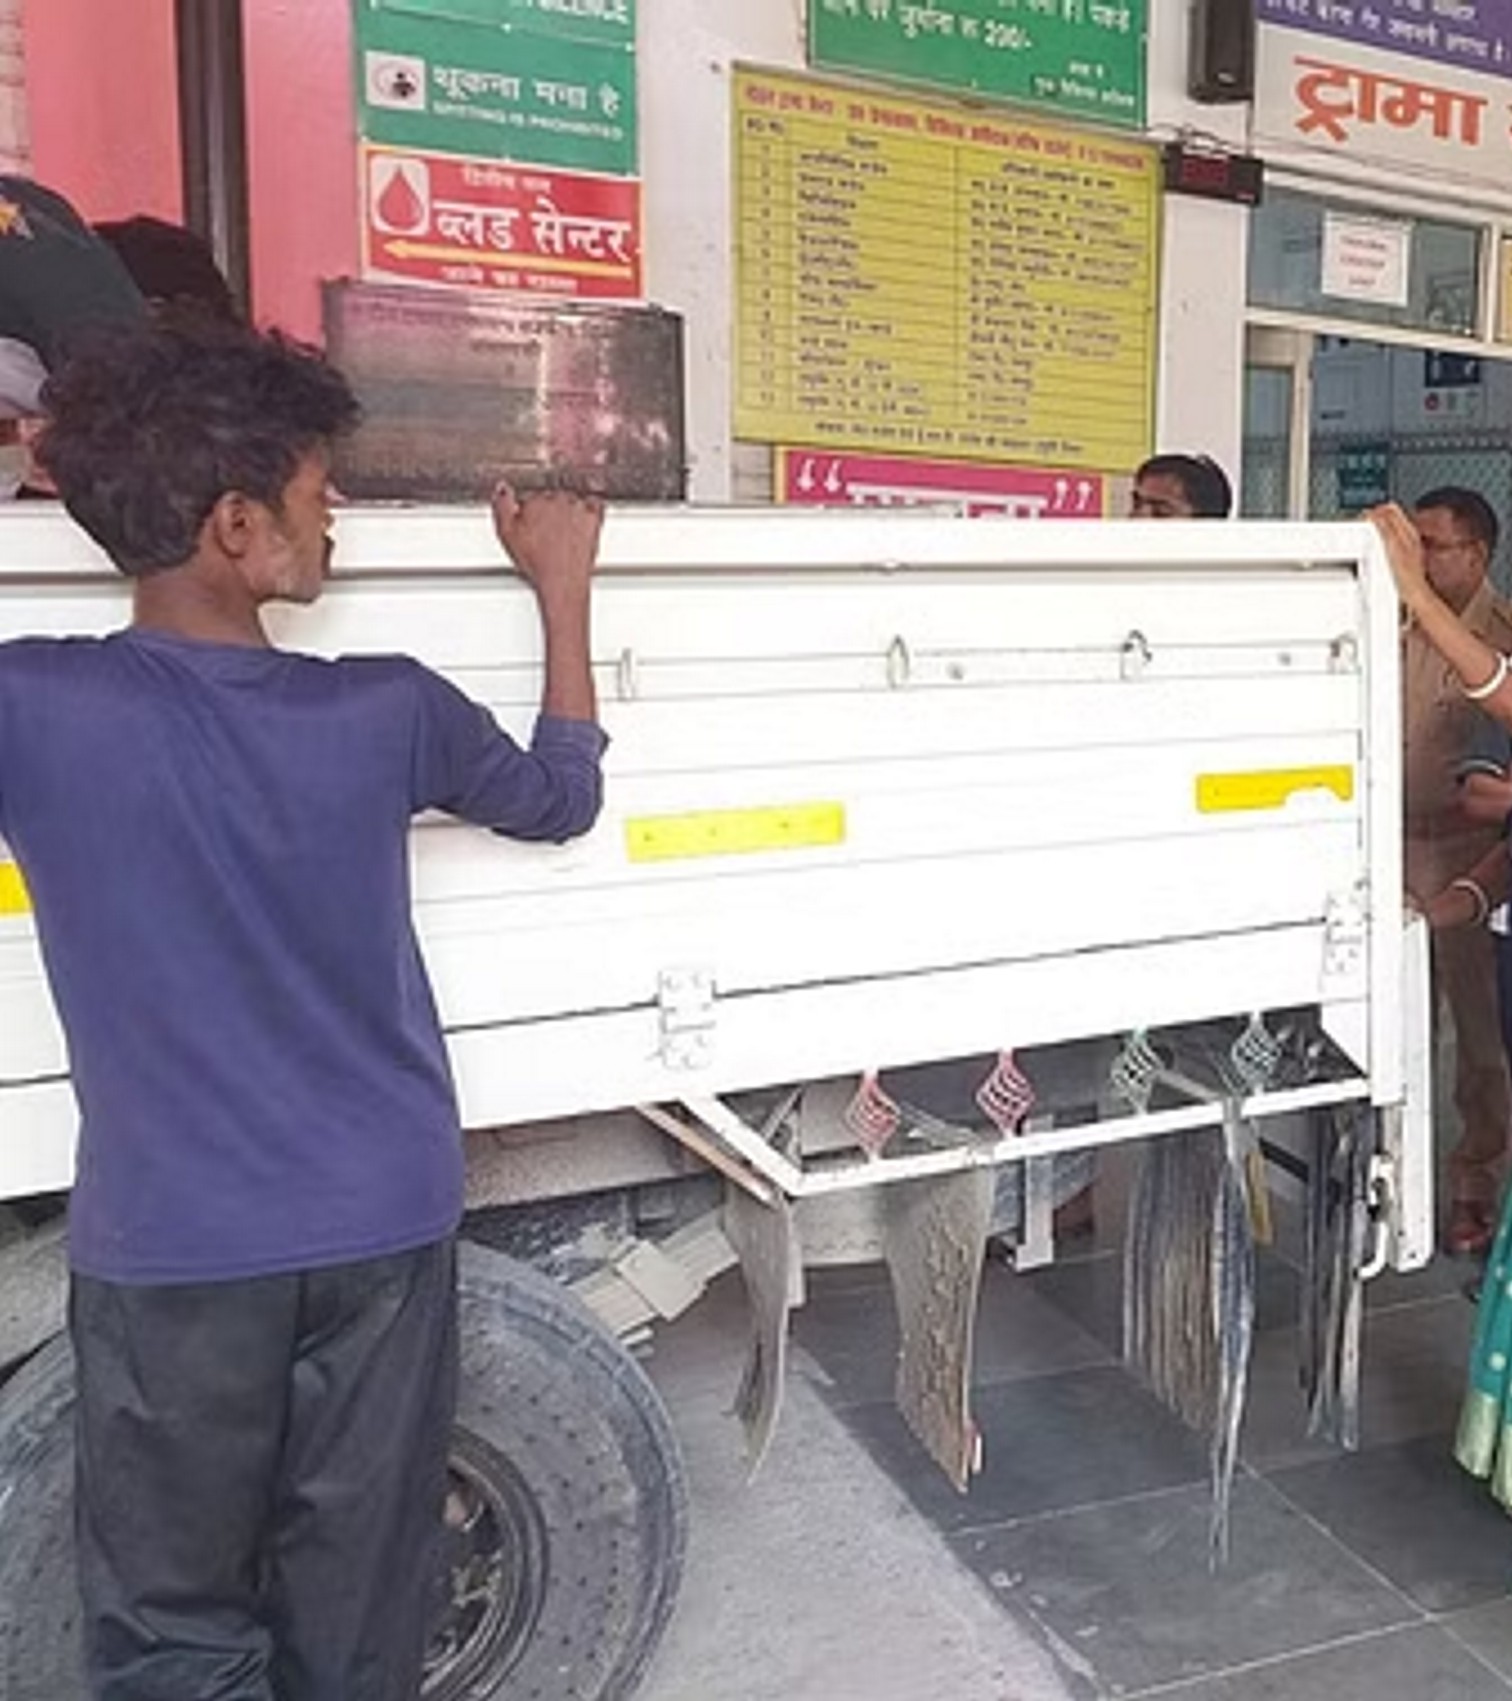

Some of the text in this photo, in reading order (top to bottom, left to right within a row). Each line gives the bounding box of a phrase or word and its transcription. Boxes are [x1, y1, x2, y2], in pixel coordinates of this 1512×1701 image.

[432, 65, 621, 118] थूकना मना है
[1294, 55, 1488, 145] ट्रामा
[432, 196, 632, 263] ब्लड सेन्टर
